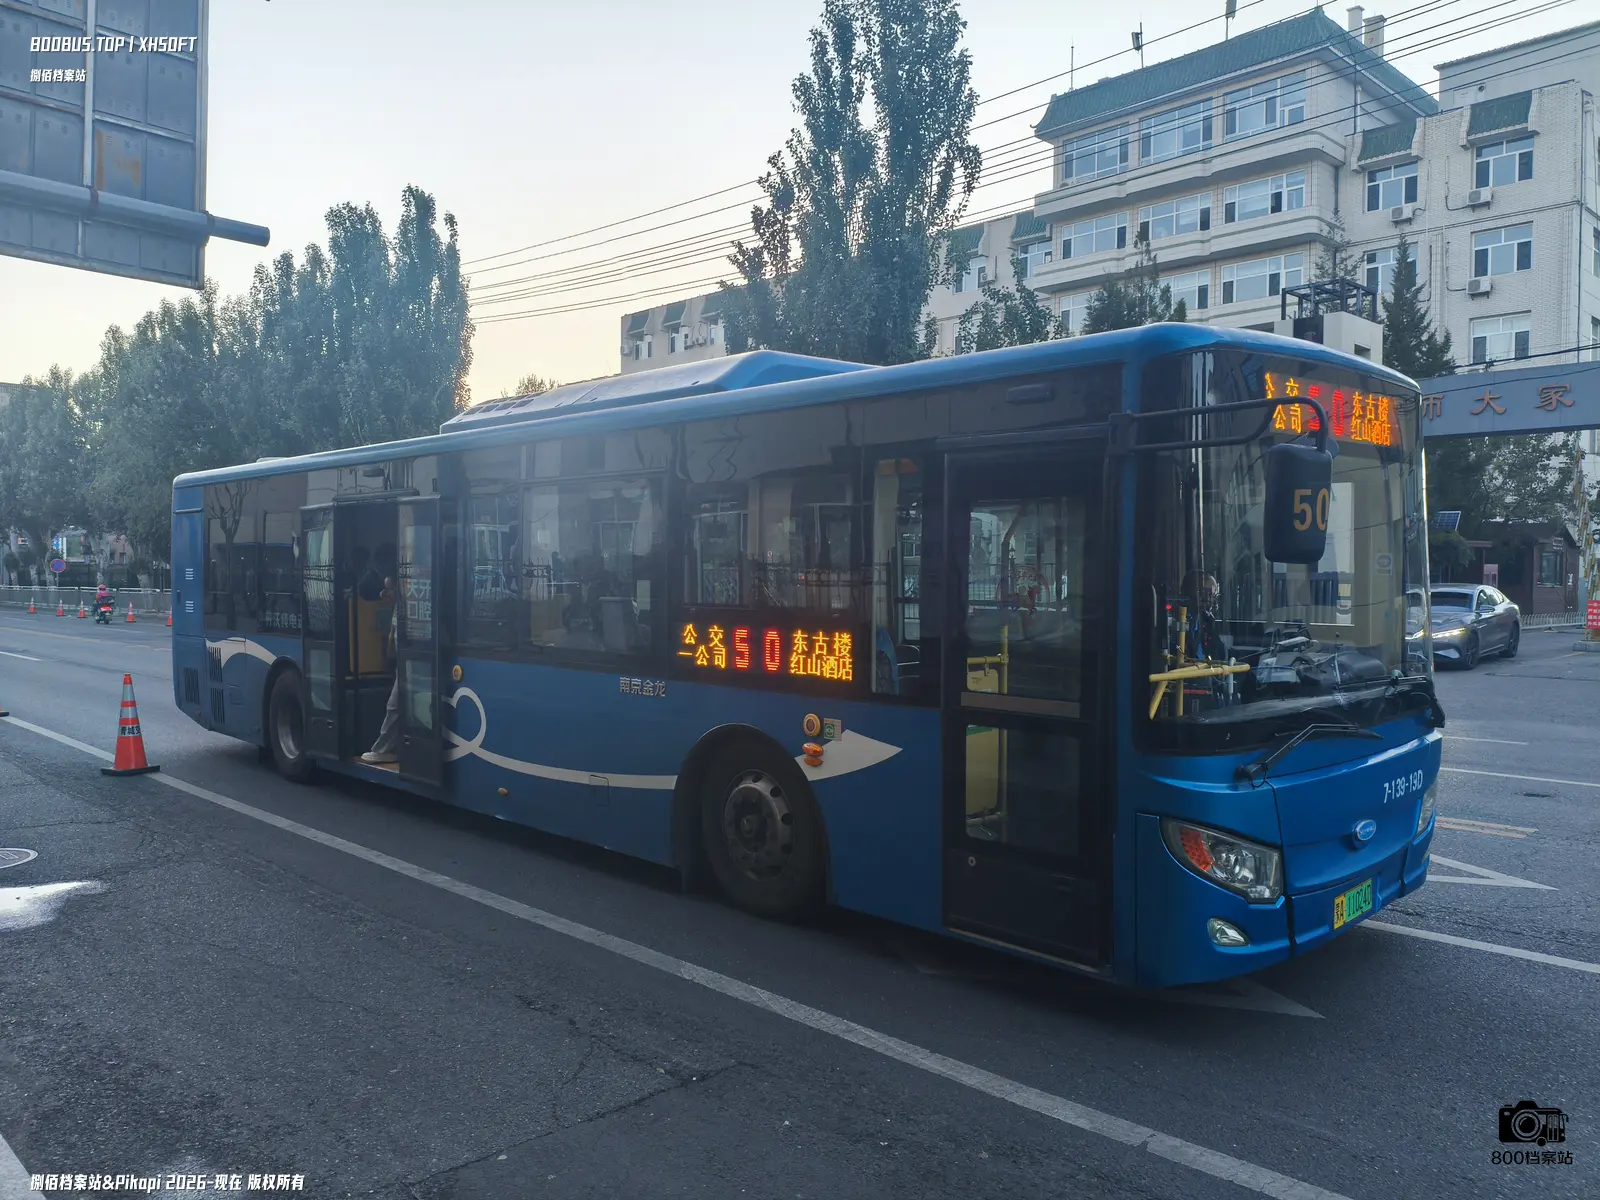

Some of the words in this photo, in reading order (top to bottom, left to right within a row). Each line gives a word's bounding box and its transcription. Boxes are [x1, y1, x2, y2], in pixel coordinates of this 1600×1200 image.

[1352, 391, 1389, 422] 东古楼
[1350, 415, 1391, 446] 红山酒店
[1292, 488, 1330, 532] 50
[683, 623, 724, 648] 公交
[734, 628, 781, 672] 50
[792, 629, 852, 658] 东古楼
[677, 644, 727, 669] 一公司
[789, 652, 853, 681] 红山酒店
[619, 676, 666, 697] 南京金龙
